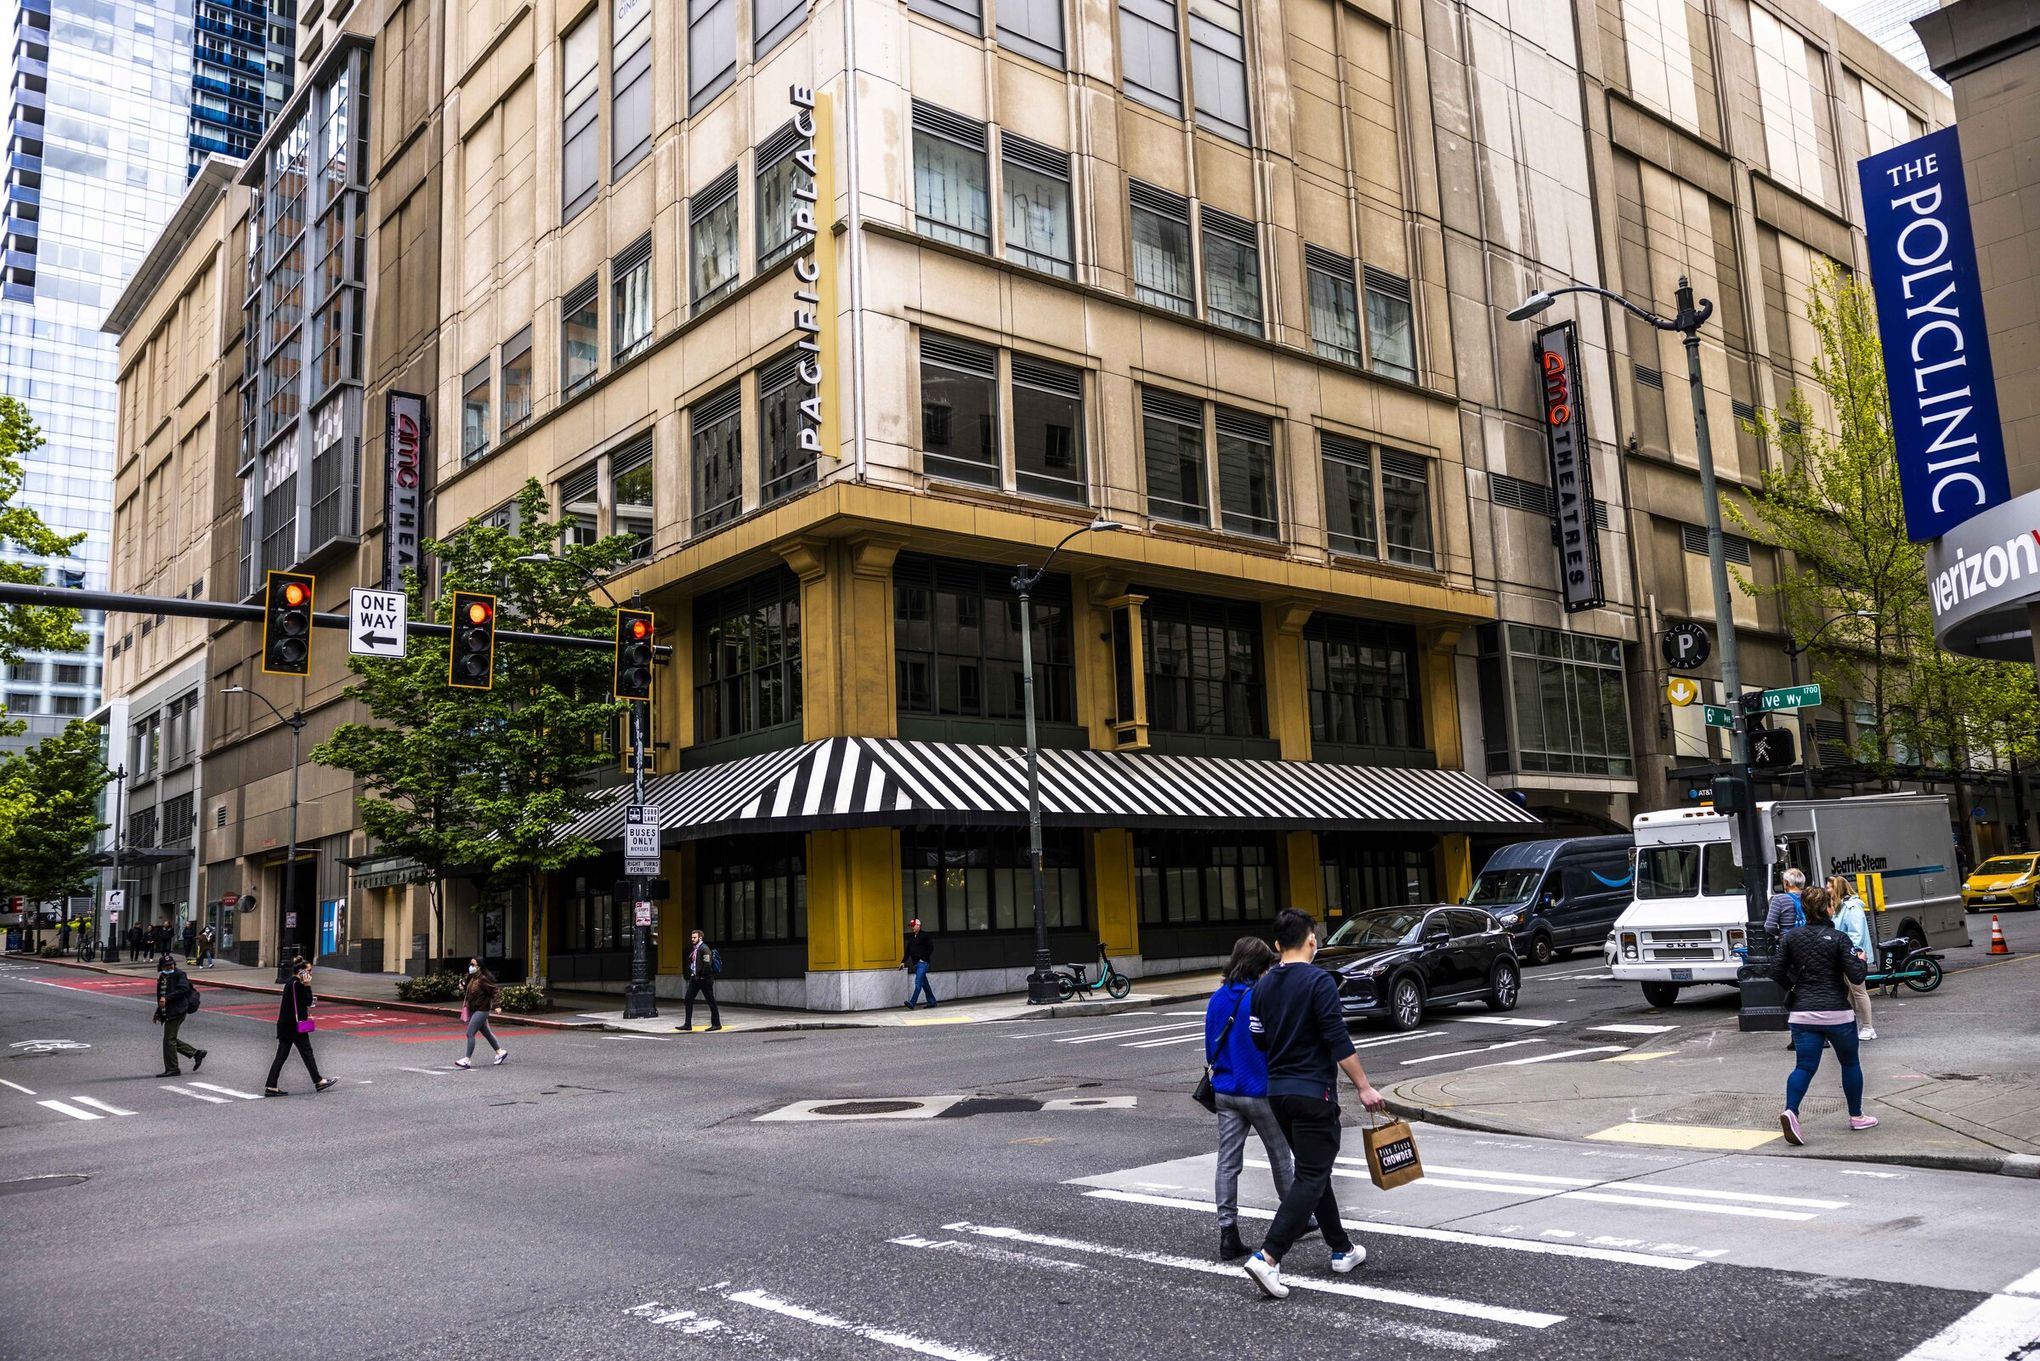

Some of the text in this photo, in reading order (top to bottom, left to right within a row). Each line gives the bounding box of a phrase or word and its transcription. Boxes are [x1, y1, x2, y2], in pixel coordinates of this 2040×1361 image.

[1887, 153, 1939, 187] THE
[789, 83, 822, 454] PACIFIC PLACE
[1891, 184, 1986, 515] POLYCLINIC
[398, 413, 420, 488] amc
[1543, 351, 1585, 587] amc THEATRES
[1931, 533, 2038, 616] verizon
[361, 594, 396, 612] ONE
[360, 612, 398, 630] WAY
[1666, 624, 1704, 642] PACIFIC
[1678, 634, 1694, 658] P
[1670, 654, 1702, 669] PLACE
[1803, 686, 1818, 694] 1700
[1786, 694, 1802, 706] Wy
[630, 829, 656, 837] BUSES
[632, 837, 653, 845] ONLY
[1830, 853, 1888, 874] Seattle Steam
[1382, 1149, 1414, 1167] CHOWDER
